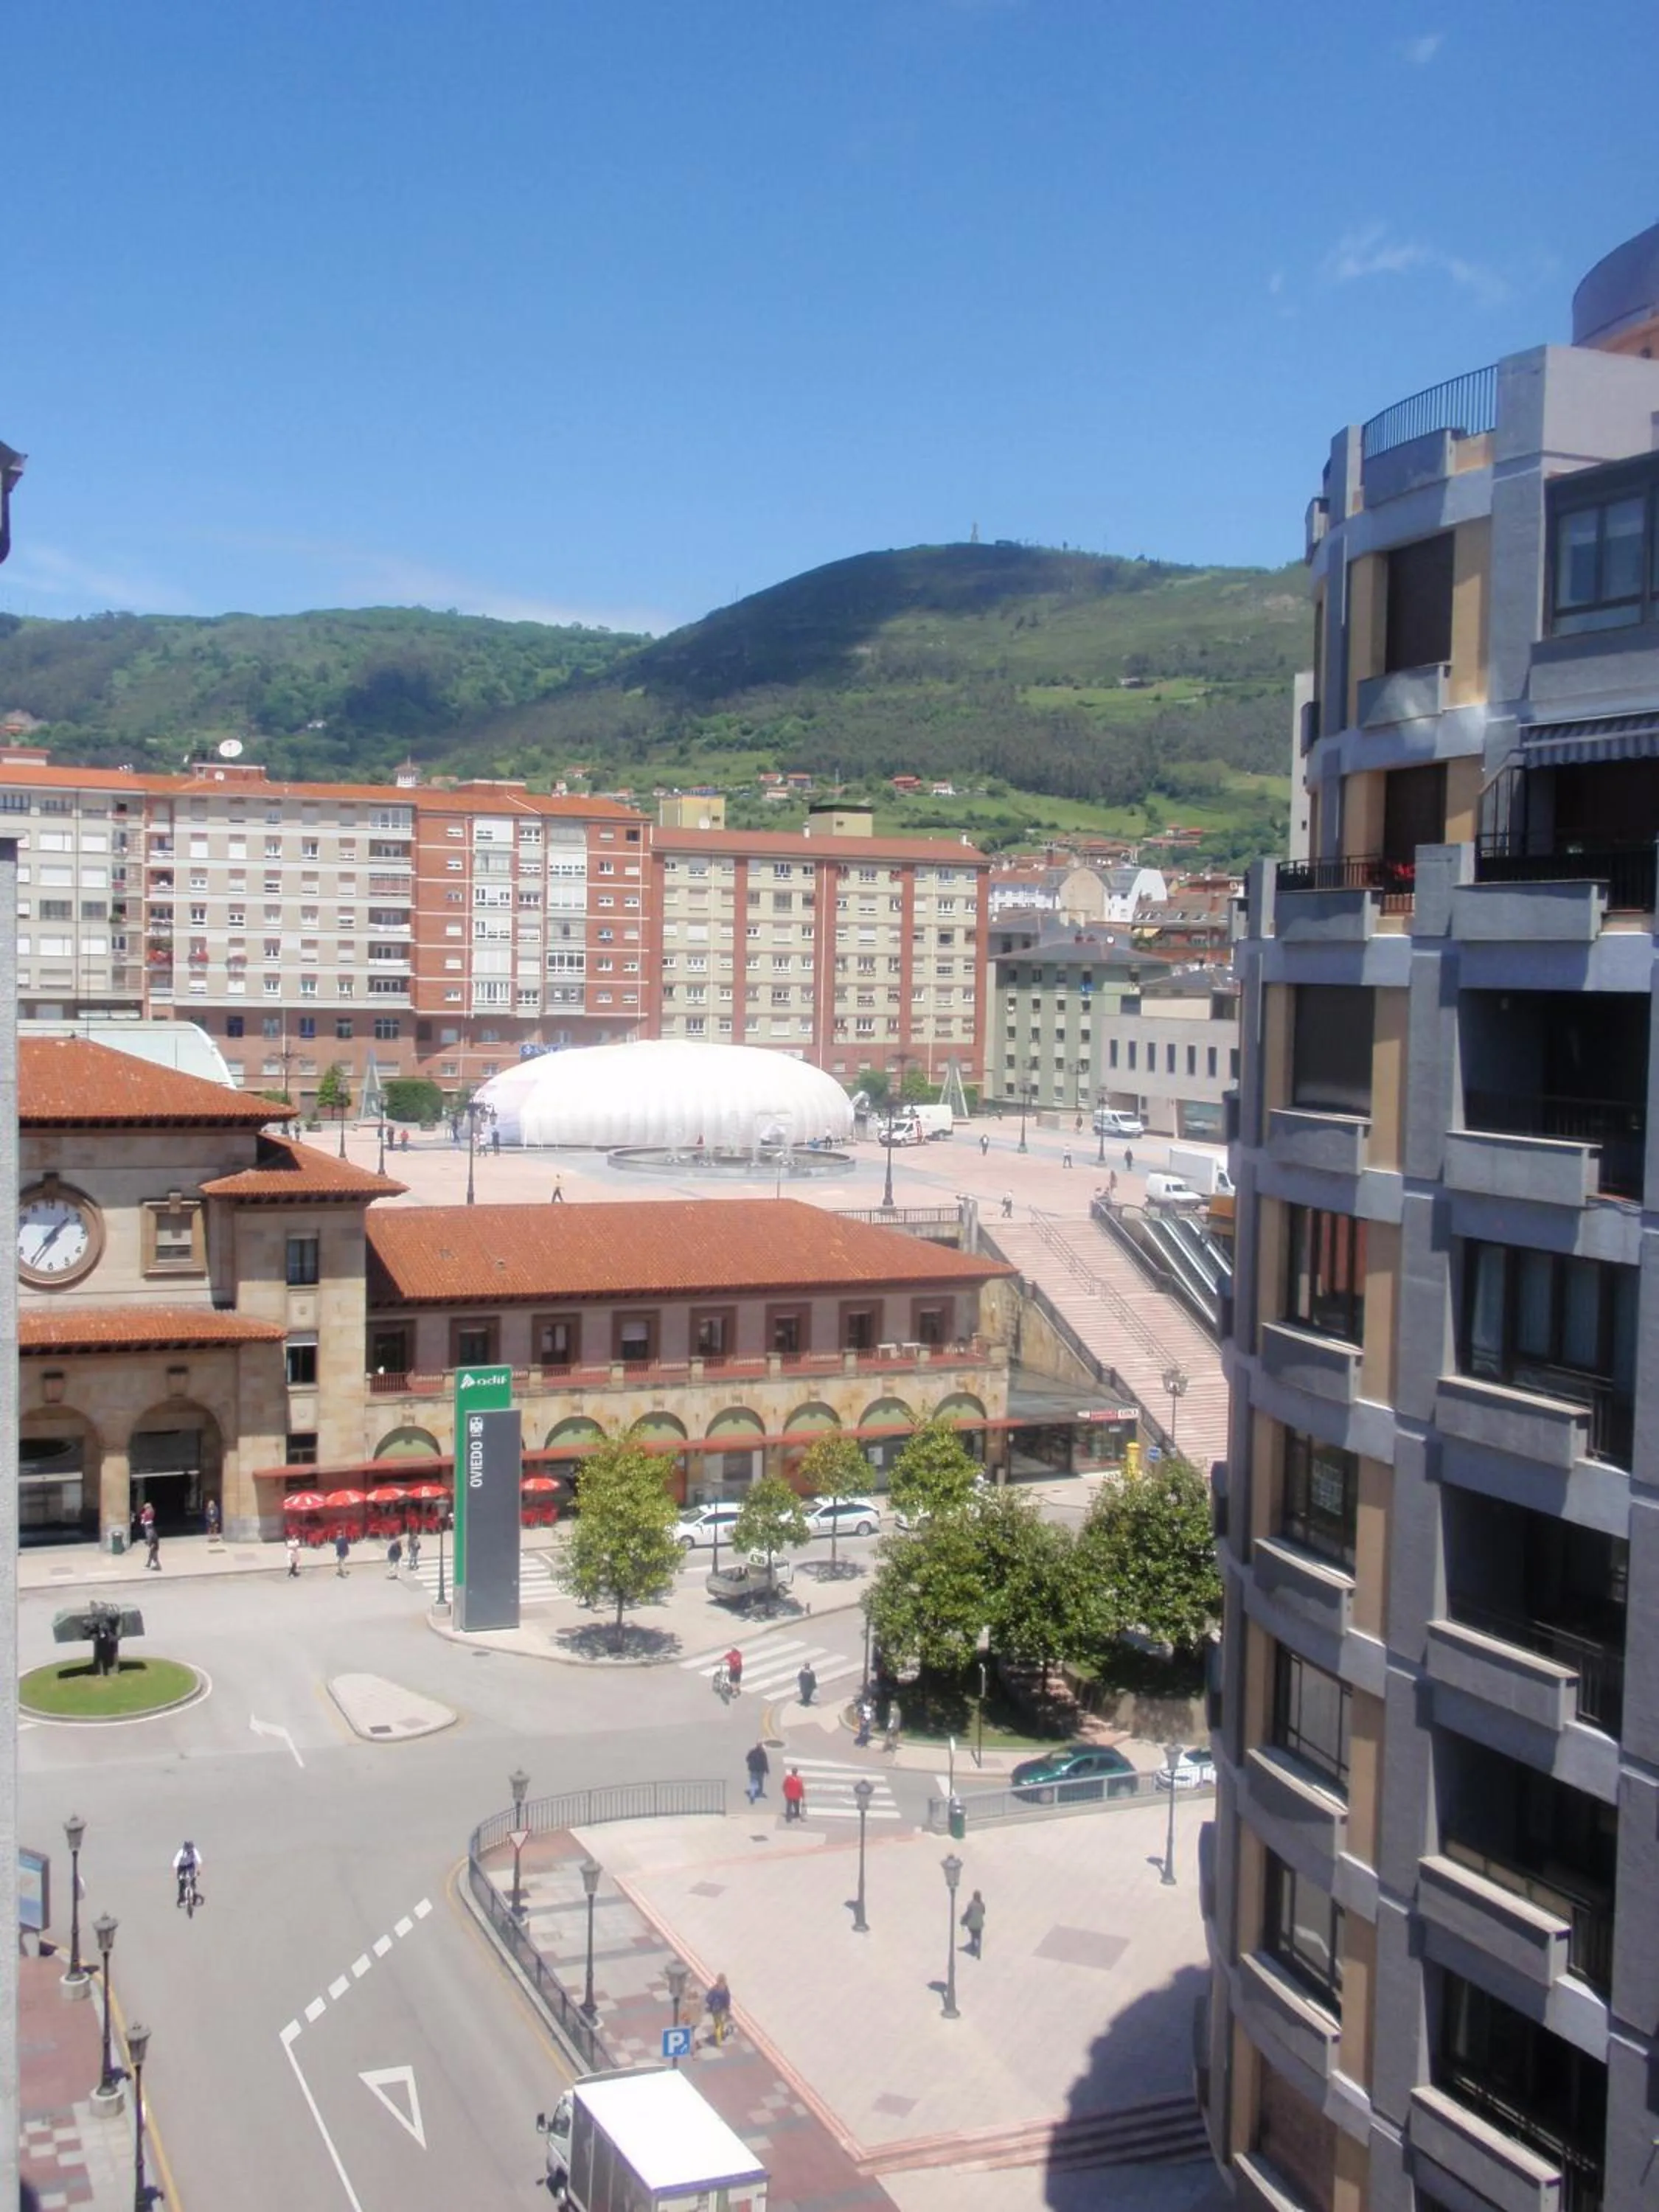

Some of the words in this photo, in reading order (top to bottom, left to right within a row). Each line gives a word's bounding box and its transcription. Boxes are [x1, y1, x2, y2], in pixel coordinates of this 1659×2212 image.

[477, 1374, 508, 1385] adif
[470, 1441, 483, 1488] OVIEDO
[668, 2032, 684, 2053] P
